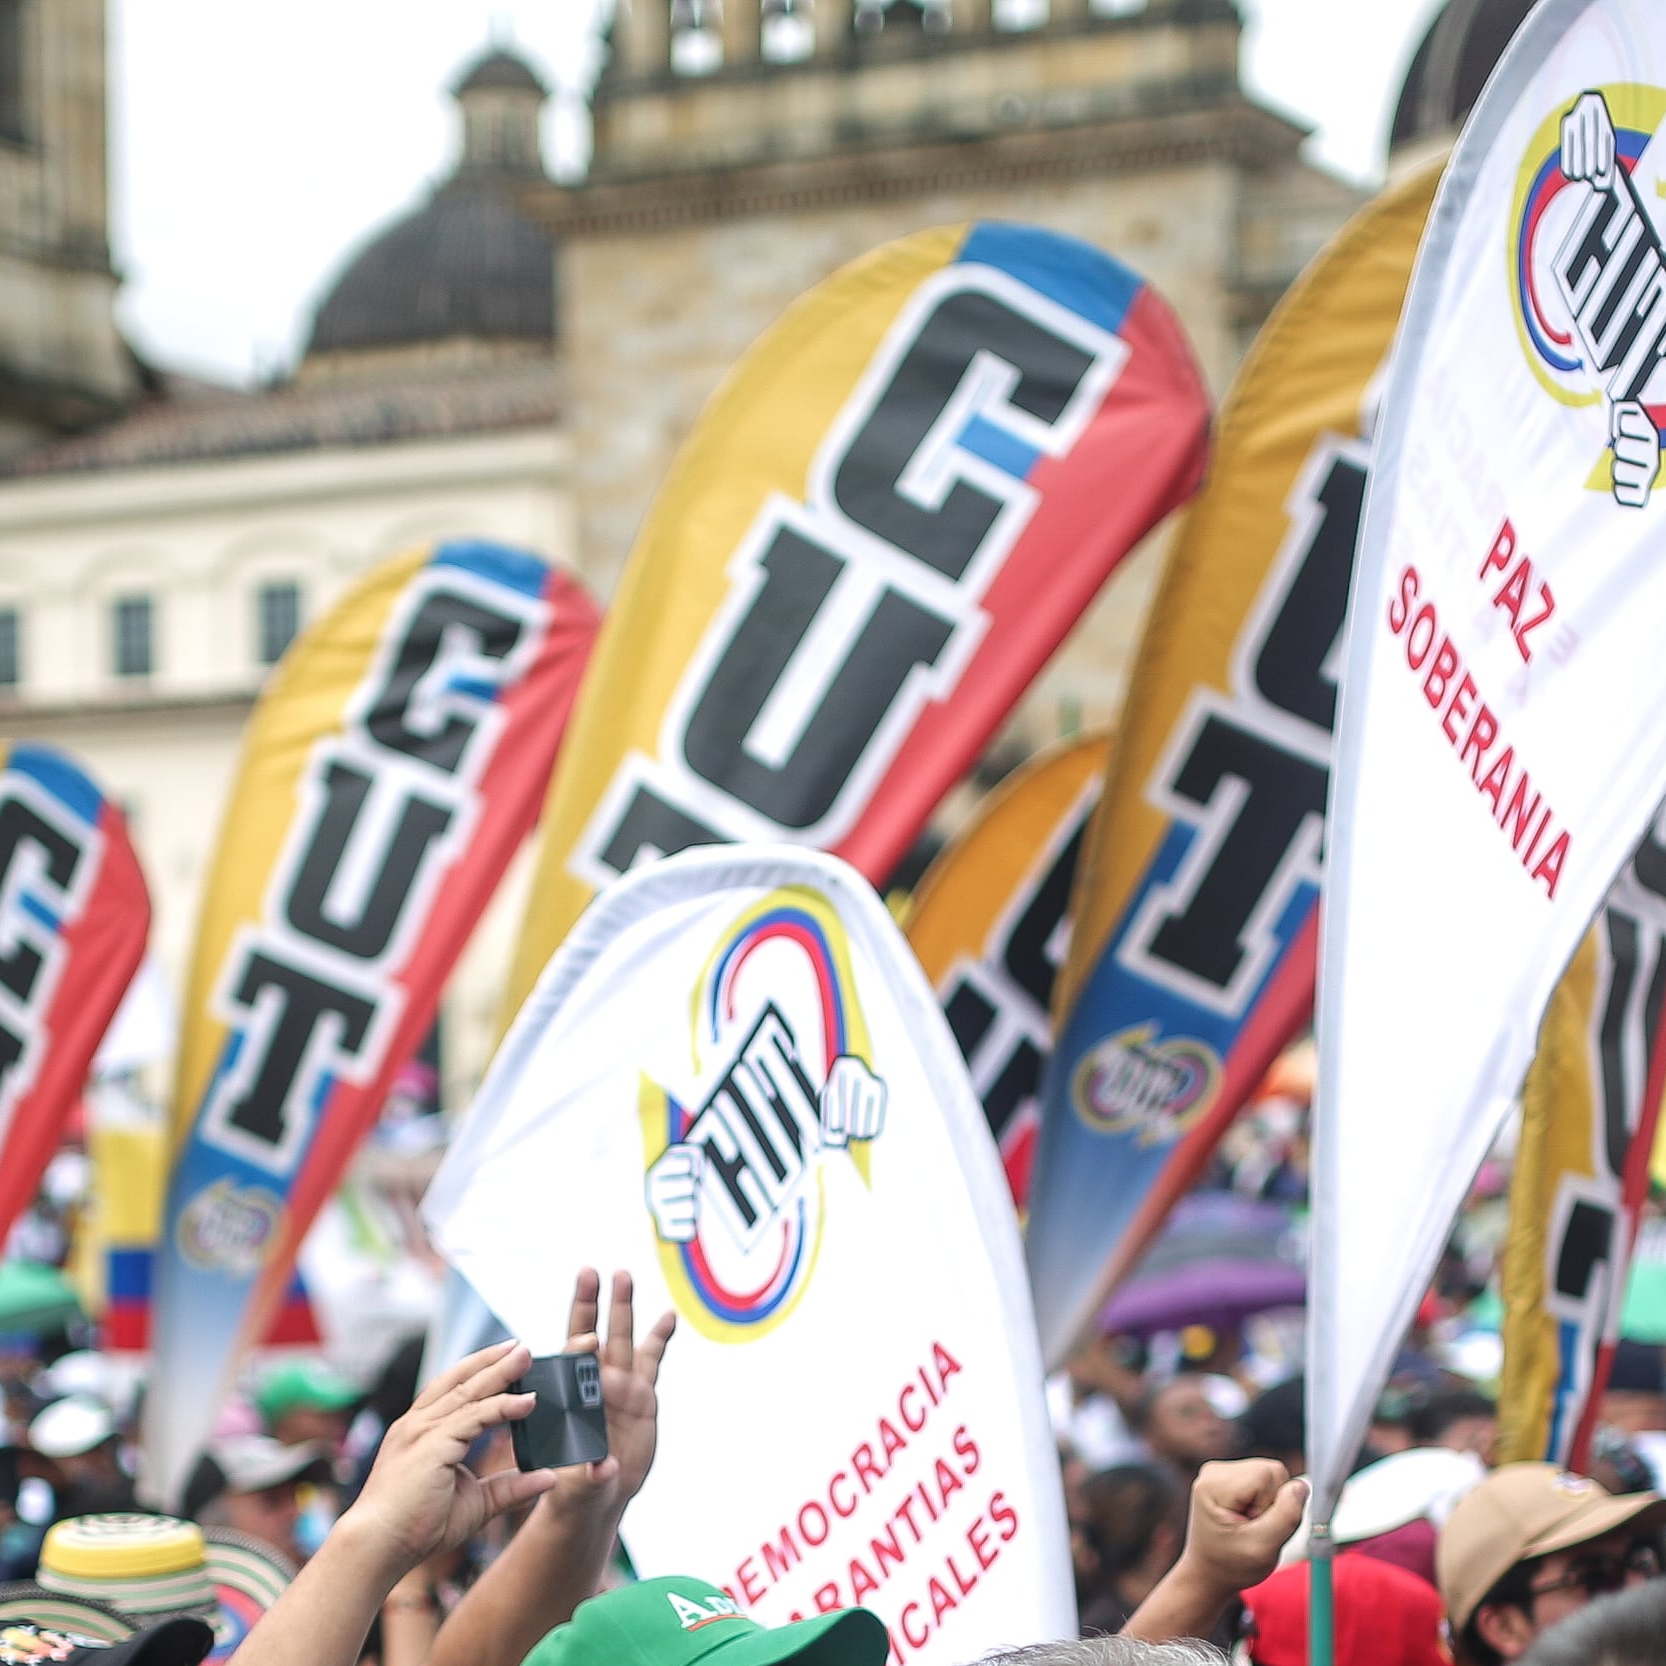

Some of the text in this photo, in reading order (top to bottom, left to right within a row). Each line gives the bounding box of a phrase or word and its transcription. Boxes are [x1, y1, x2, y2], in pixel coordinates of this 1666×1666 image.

[595, 283, 1108, 876] CU
[1389, 563, 1573, 902] SOBERANIA
[1479, 515, 1555, 664] PAZ
[220, 578, 538, 1160] CUT
[721, 1339, 963, 1606] EMOCRACIA
